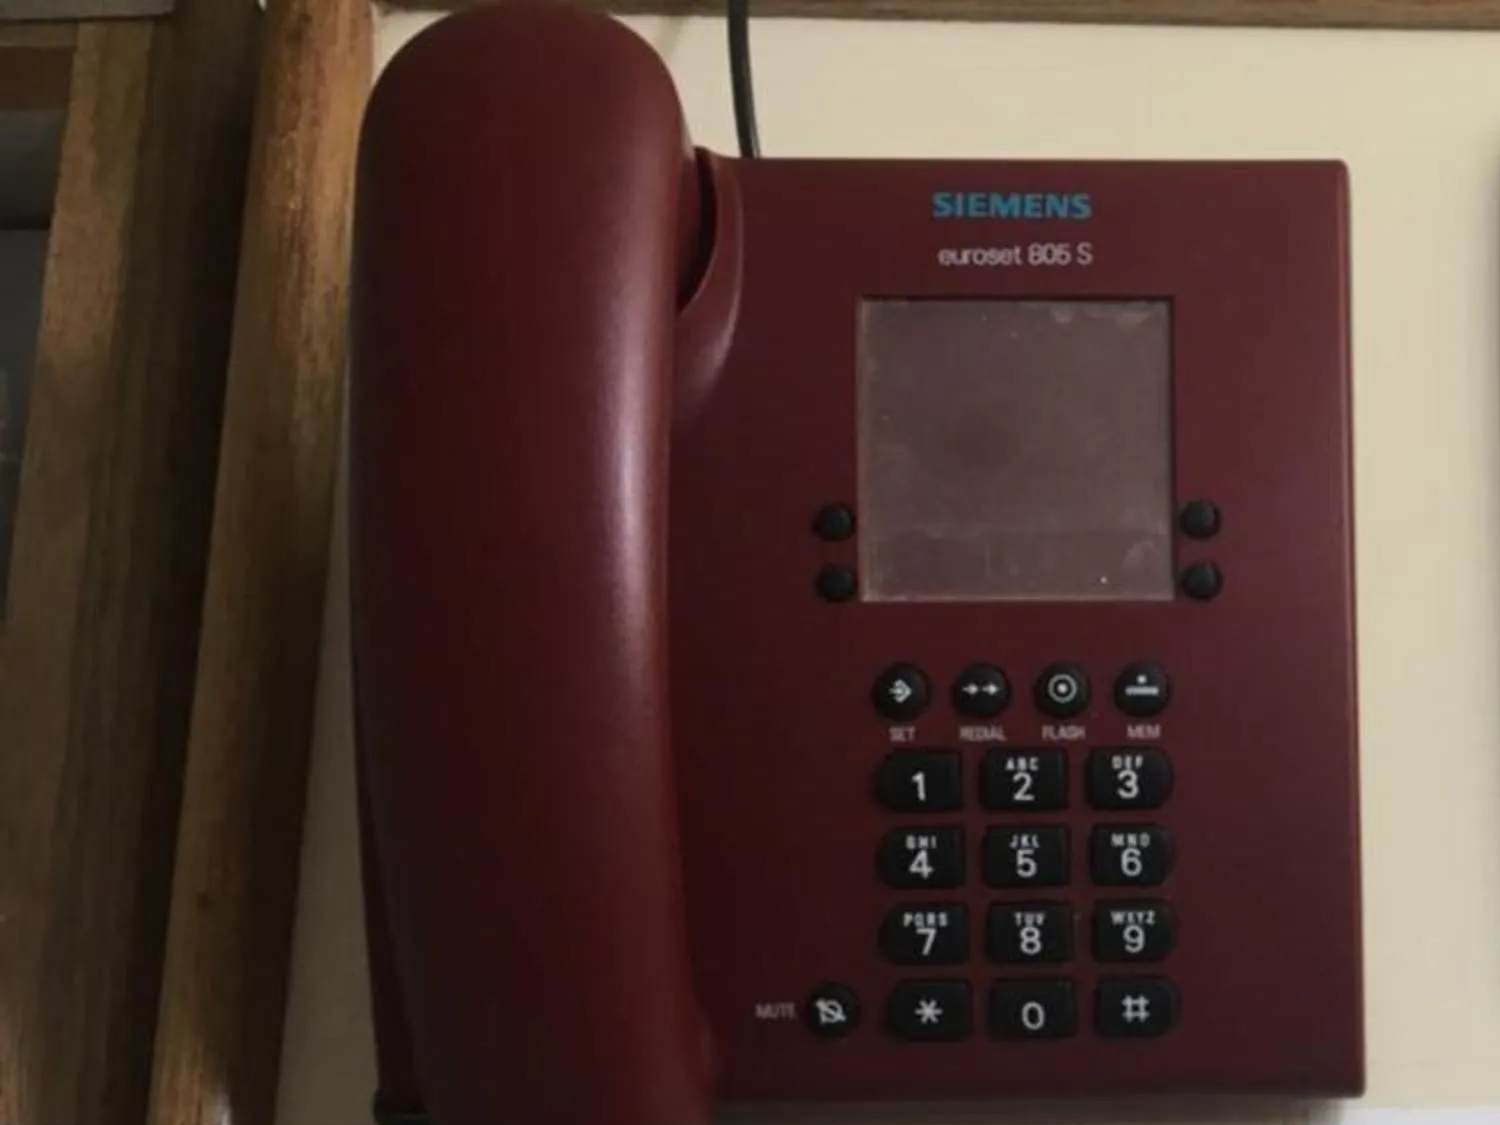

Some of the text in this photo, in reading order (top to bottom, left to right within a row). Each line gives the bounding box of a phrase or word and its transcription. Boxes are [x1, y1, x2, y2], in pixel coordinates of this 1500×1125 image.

[932, 193, 1092, 219] SIEMENS
[938, 246, 1021, 266] euroset
[1077, 243, 1092, 264] S
[889, 726, 916, 741] SET
[960, 726, 1006, 742] REDIAL
[1042, 726, 1086, 741] FLASH
[1127, 725, 1160, 740] MEM
[911, 772, 927, 801] 1
[1012, 773, 1035, 801] 2
[1117, 771, 1139, 800] 3
[909, 850, 934, 878] 4
[1015, 850, 1038, 878] 5
[1120, 848, 1142, 877] 6
[916, 929, 936, 956] 7
[1020, 927, 1042, 955] 8
[1123, 926, 1145, 954] 9
[755, 1004, 796, 1018] MUTE
